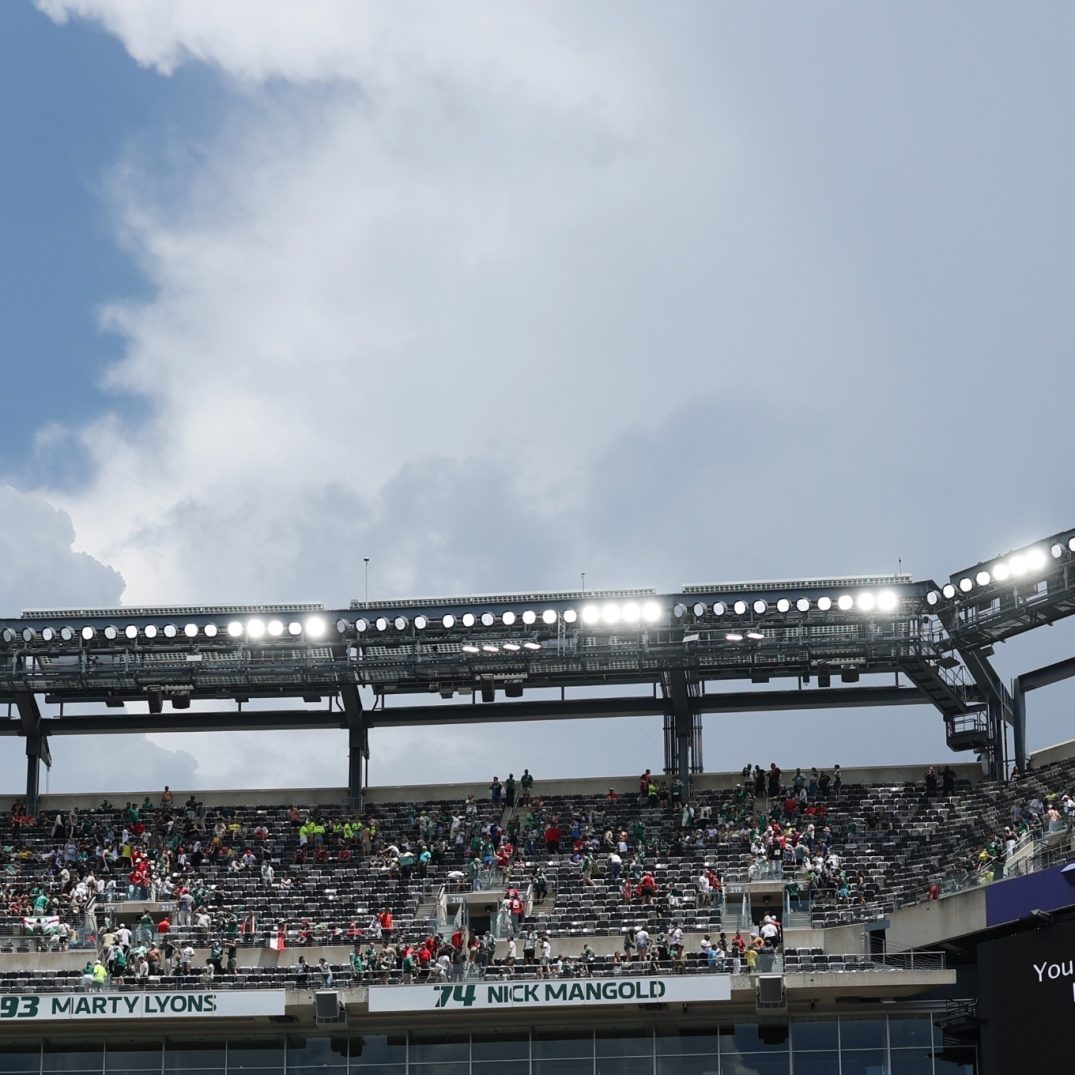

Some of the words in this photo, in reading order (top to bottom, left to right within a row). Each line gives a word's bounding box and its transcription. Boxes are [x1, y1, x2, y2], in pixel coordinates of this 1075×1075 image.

[0, 996, 40, 1018] 93
[51, 995, 140, 1015] MARTY
[144, 994, 217, 1014] LYONS
[433, 984, 477, 1008] 74
[487, 984, 540, 1004] NICK
[545, 980, 666, 1002] MANGOLD
